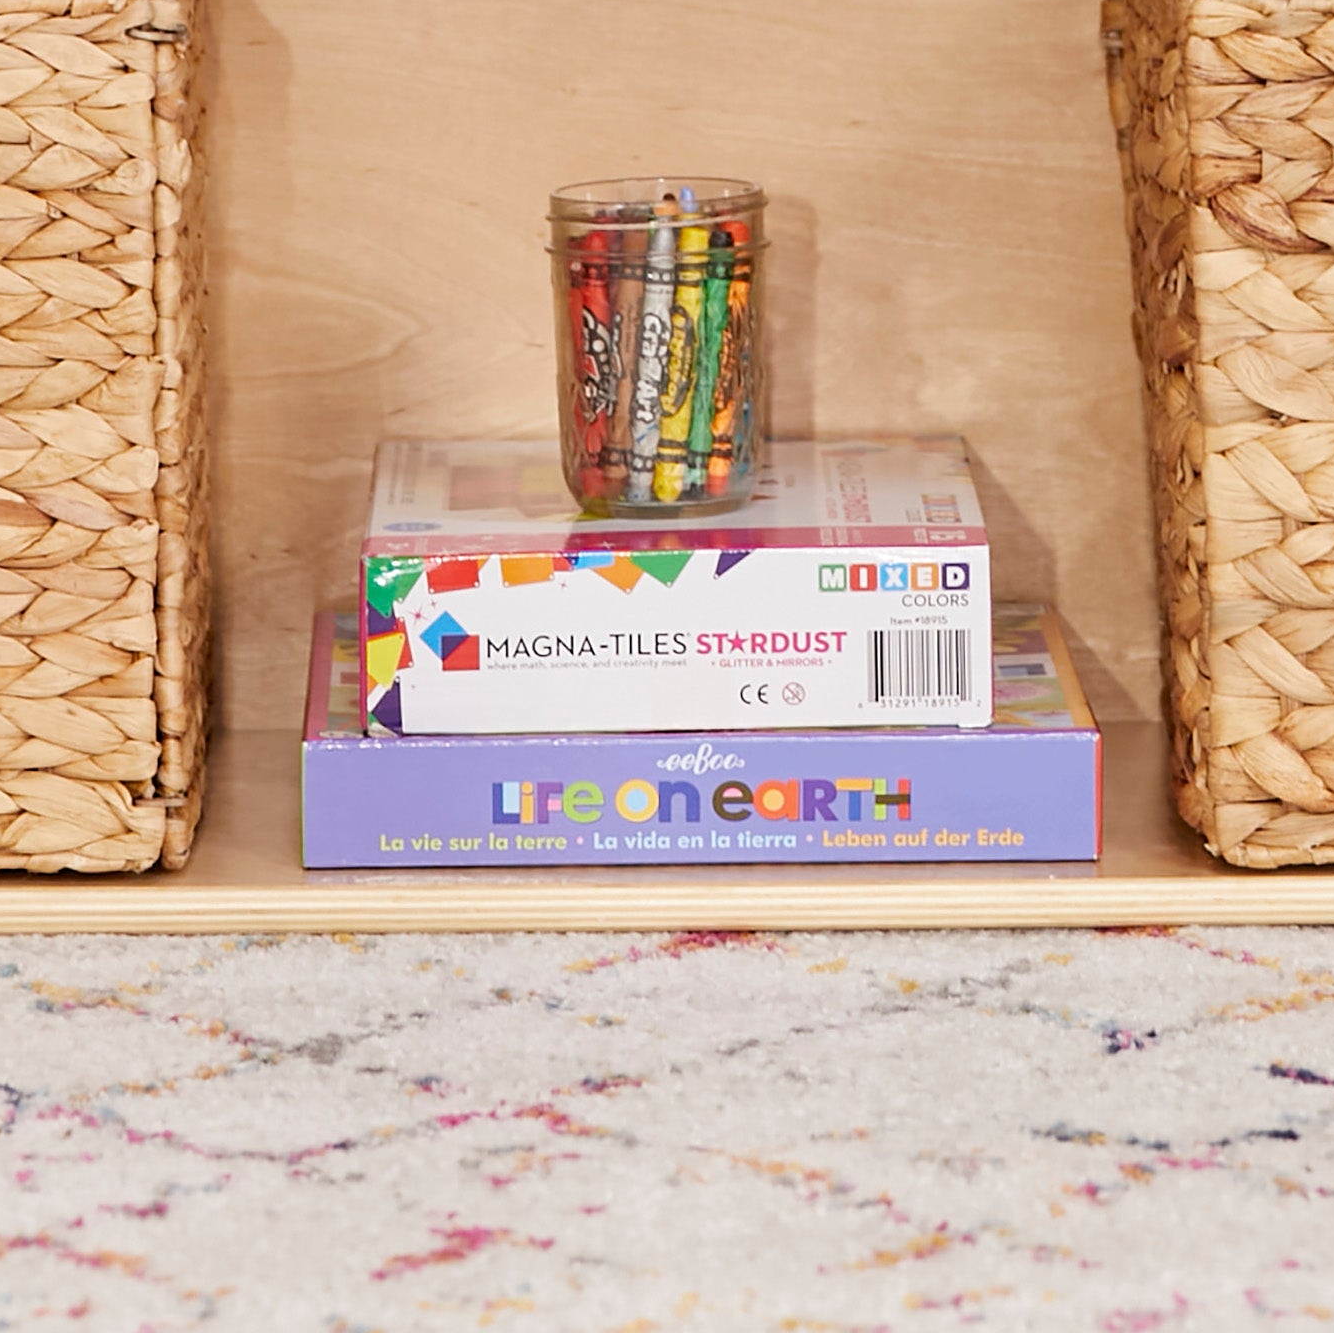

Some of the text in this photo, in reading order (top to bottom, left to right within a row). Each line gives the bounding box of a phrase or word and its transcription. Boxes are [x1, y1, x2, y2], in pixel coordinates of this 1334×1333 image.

[820, 564, 968, 590] MIXED
[902, 594, 969, 608] COLORS
[890, 616, 913, 625] Item
[487, 660, 517, 670] where
[593, 658, 611, 668] and
[613, 658, 658, 669] creativity
[661, 658, 687, 667] meet
[719, 657, 825, 668] GLITTER MIRRORS
[739, 683, 770, 705] CE
[615, 778, 701, 824] on
[379, 832, 568, 851] La vie sur la terre
[593, 830, 797, 850] La vida en la tierra
[822, 827, 1025, 848] Leben auf der Erde
